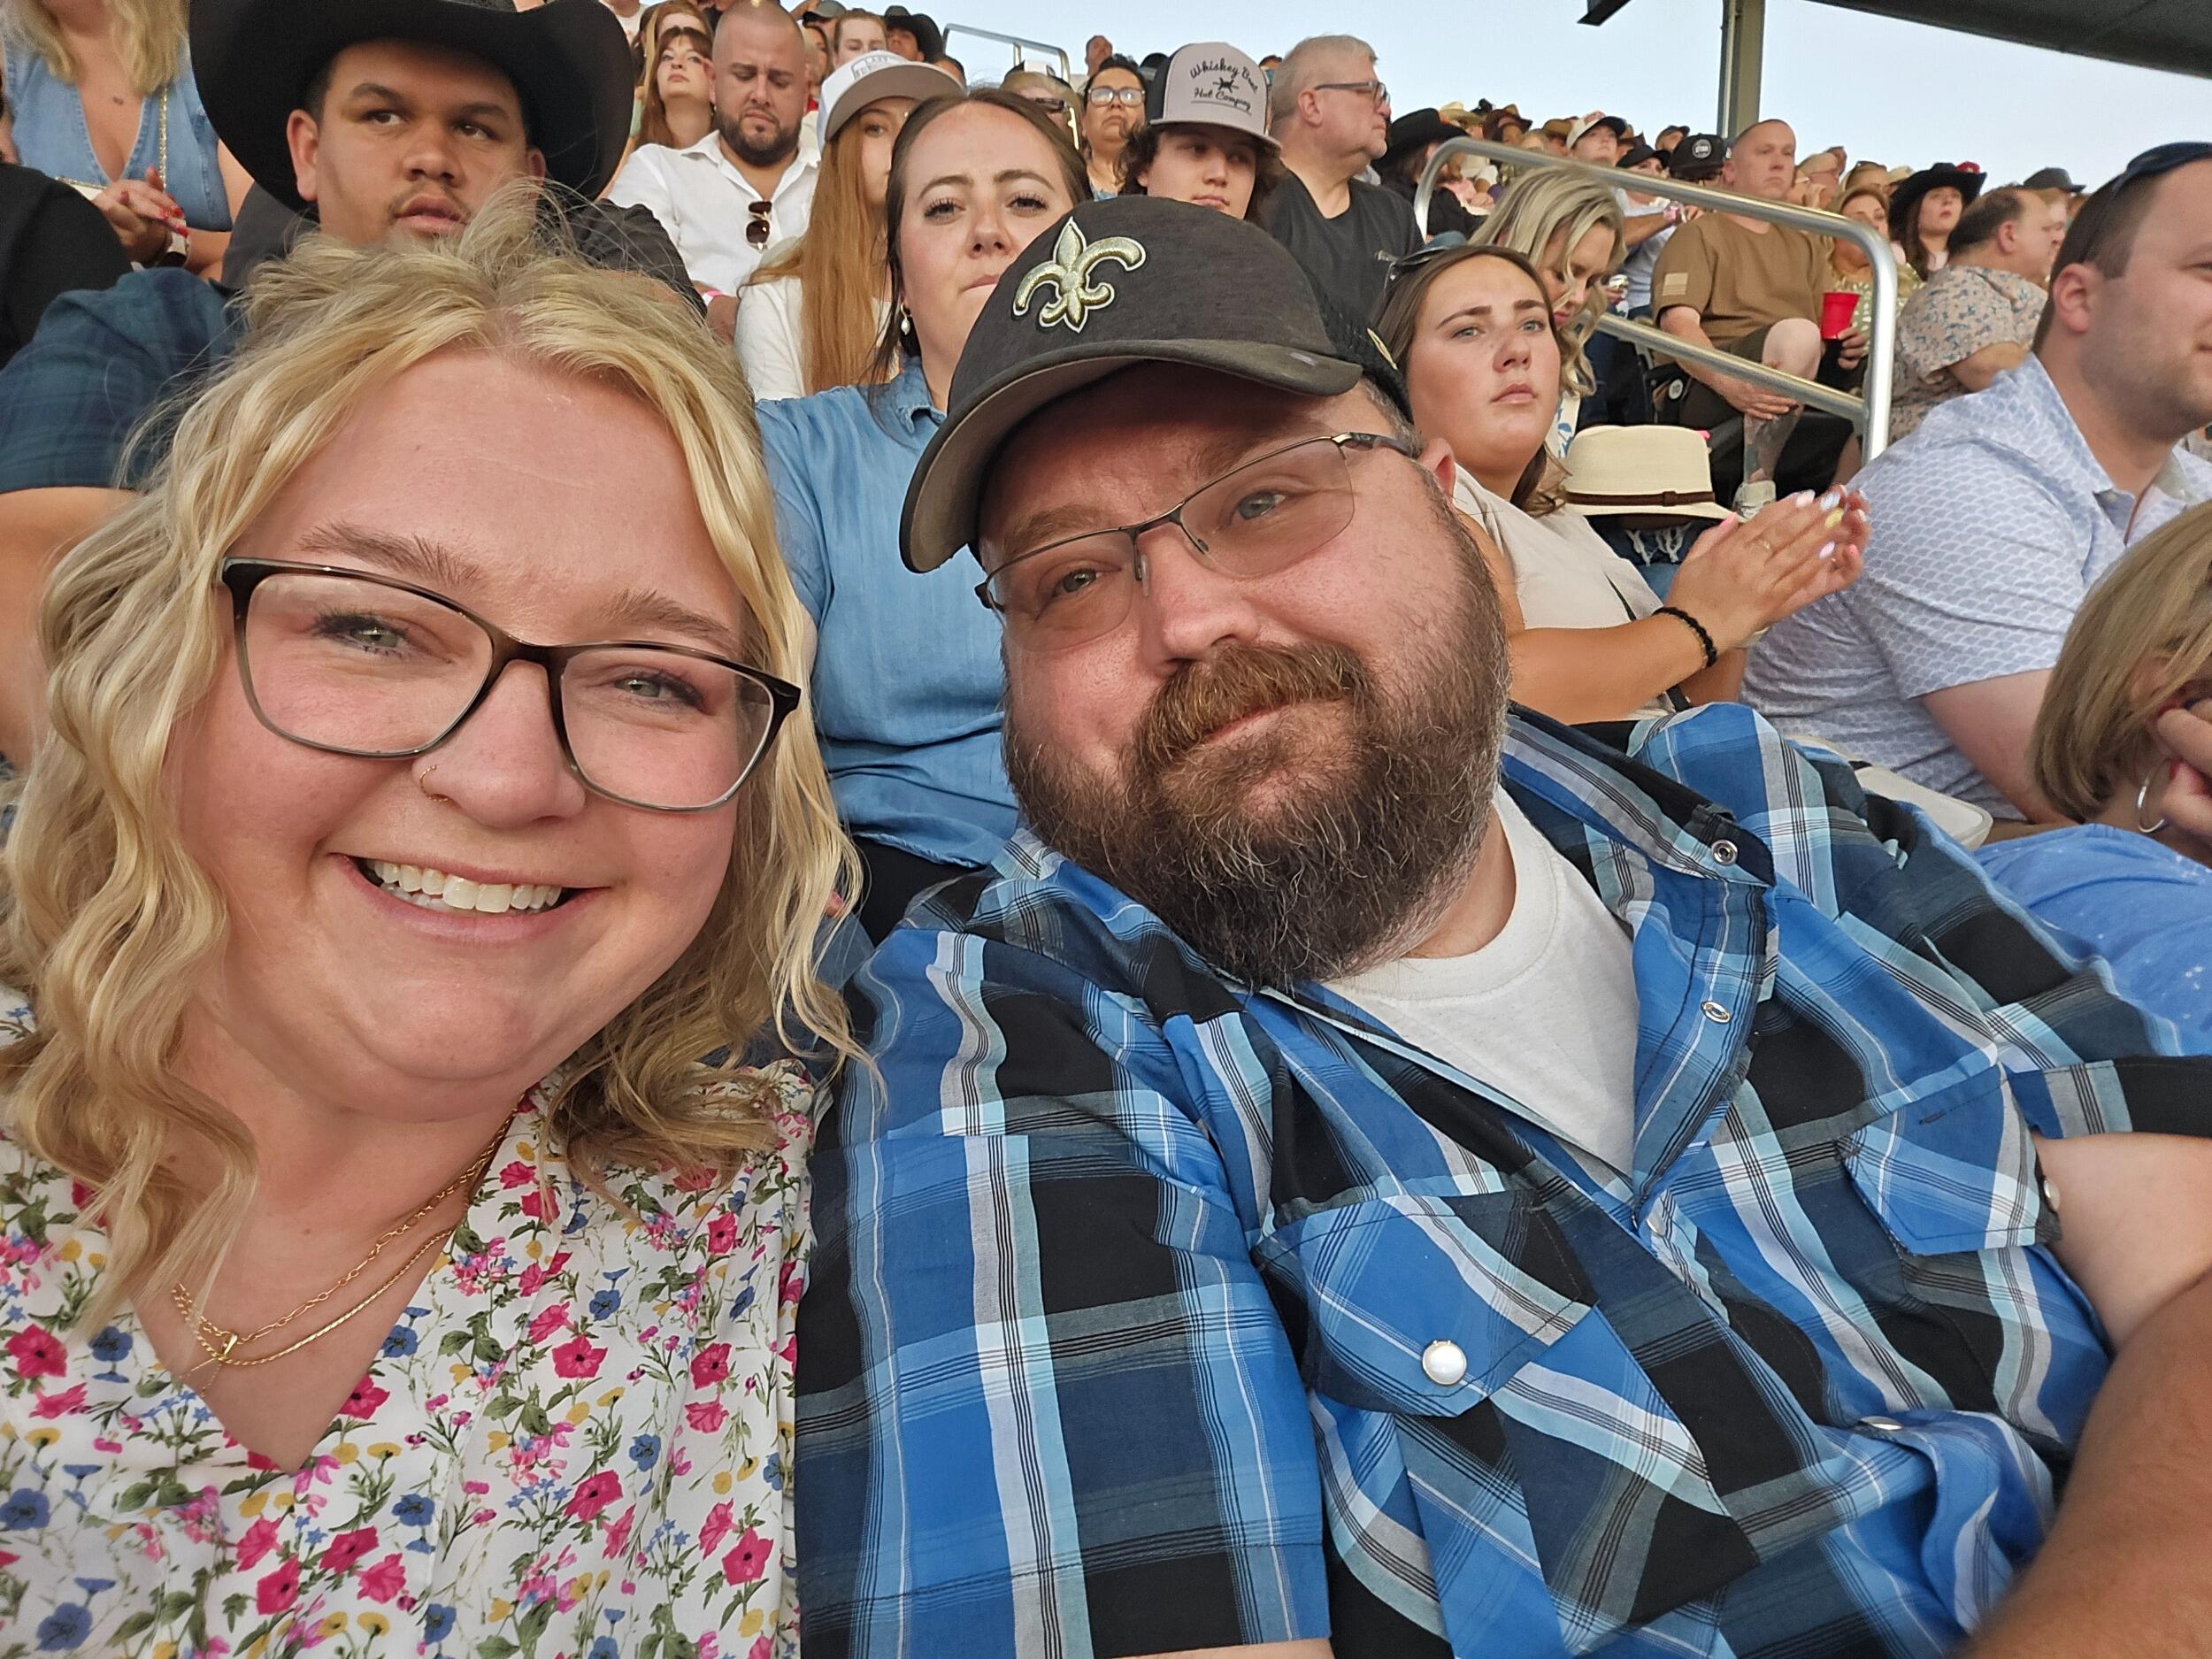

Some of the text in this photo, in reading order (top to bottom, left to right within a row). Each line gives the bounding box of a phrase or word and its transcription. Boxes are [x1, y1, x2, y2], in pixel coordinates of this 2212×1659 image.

[1190, 58, 1240, 80] Whiskey
[1194, 87, 1251, 111] Hat Company
